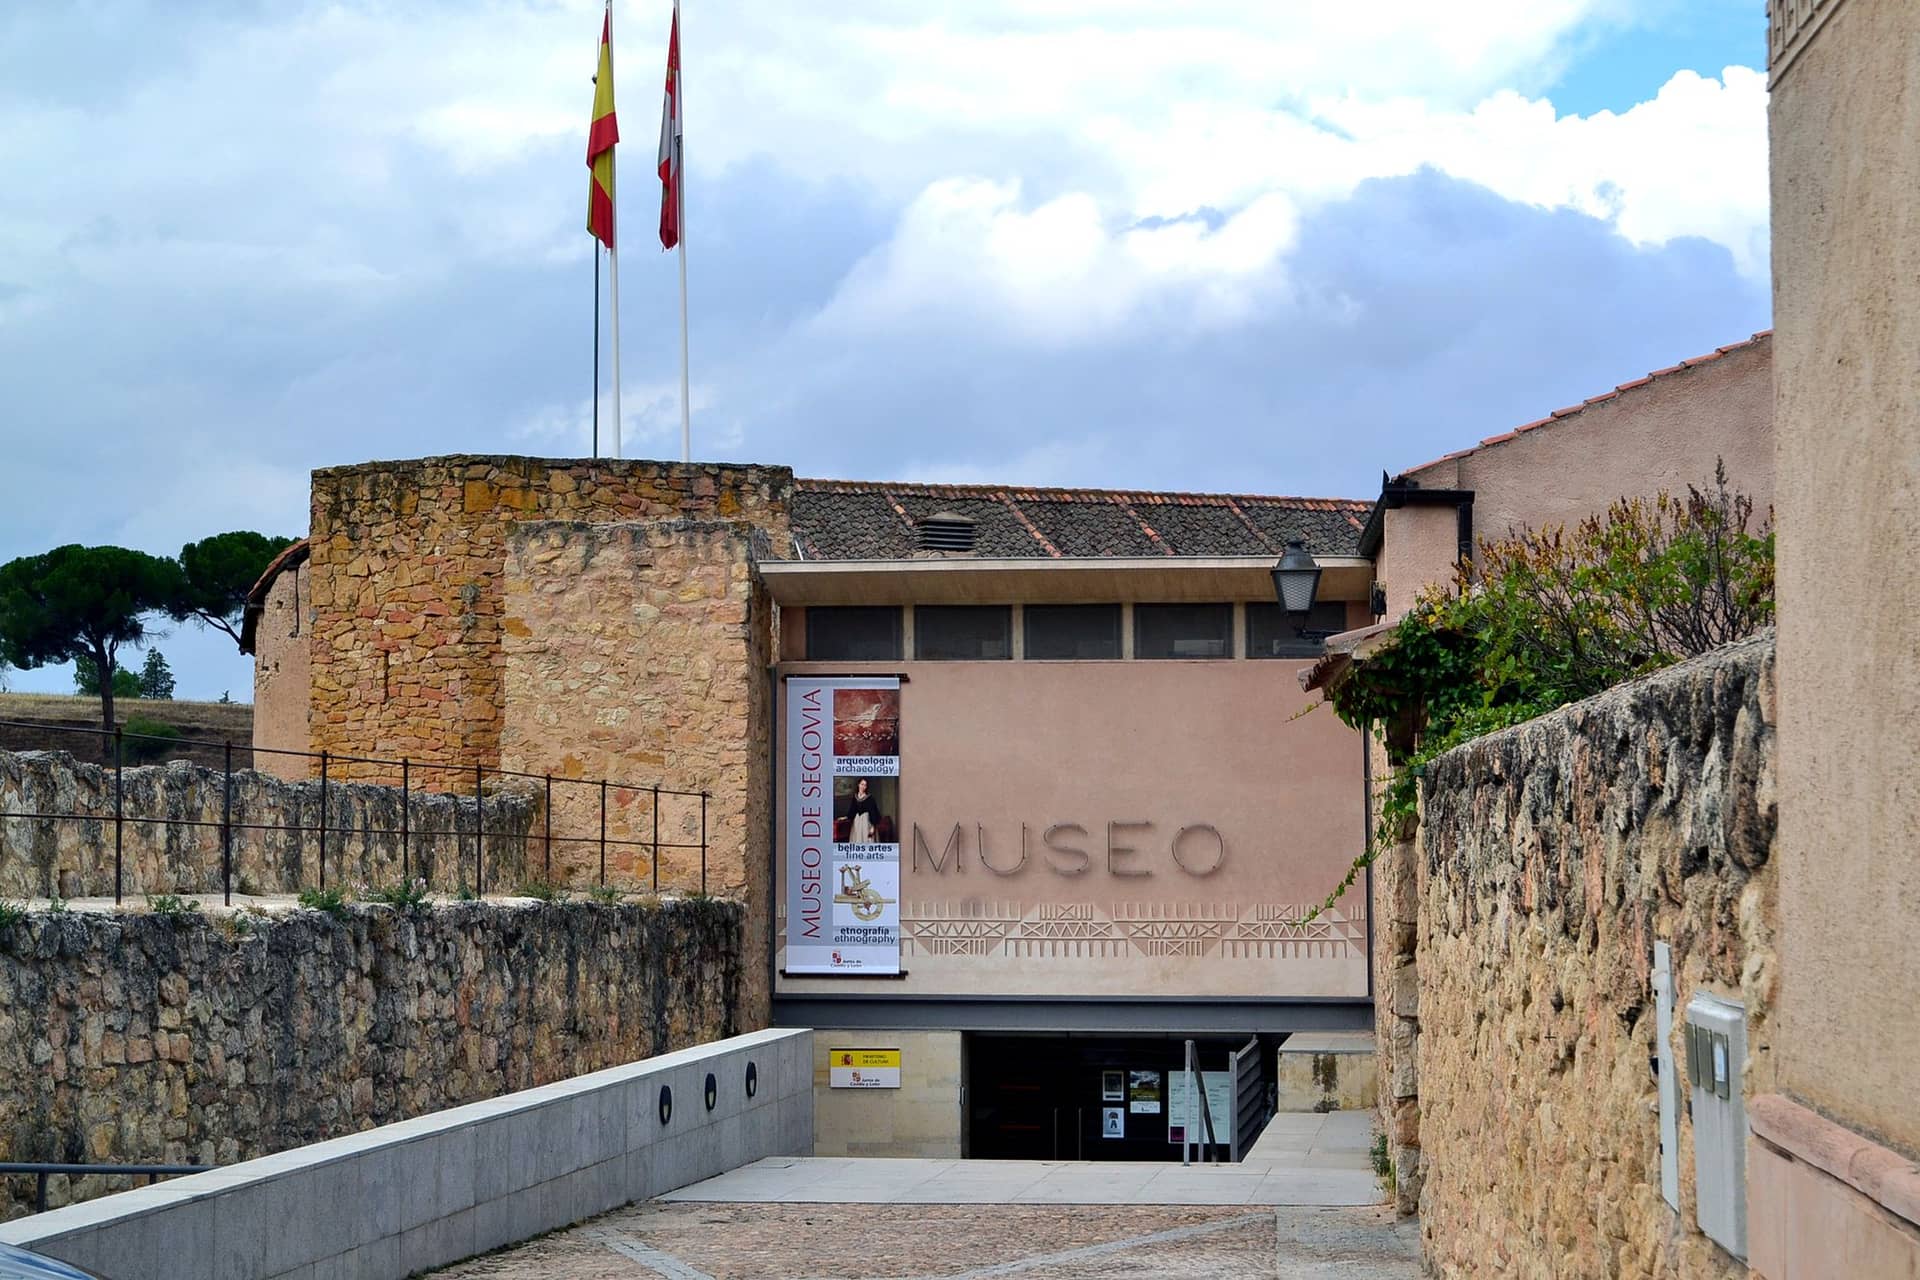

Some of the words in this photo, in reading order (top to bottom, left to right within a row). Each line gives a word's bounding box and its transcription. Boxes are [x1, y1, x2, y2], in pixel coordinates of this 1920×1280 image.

[801, 688, 821, 798] SEGOVIA
[835, 764, 895, 775] archaeology
[801, 807, 821, 838] DE
[837, 843, 866, 852] bellas
[868, 844, 893, 852] artes
[846, 850, 864, 860] fine
[866, 852, 885, 860] arts
[913, 821, 1226, 877] MUSEO
[801, 847, 821, 938] MUSEO
[834, 934, 896, 945] ethnography
